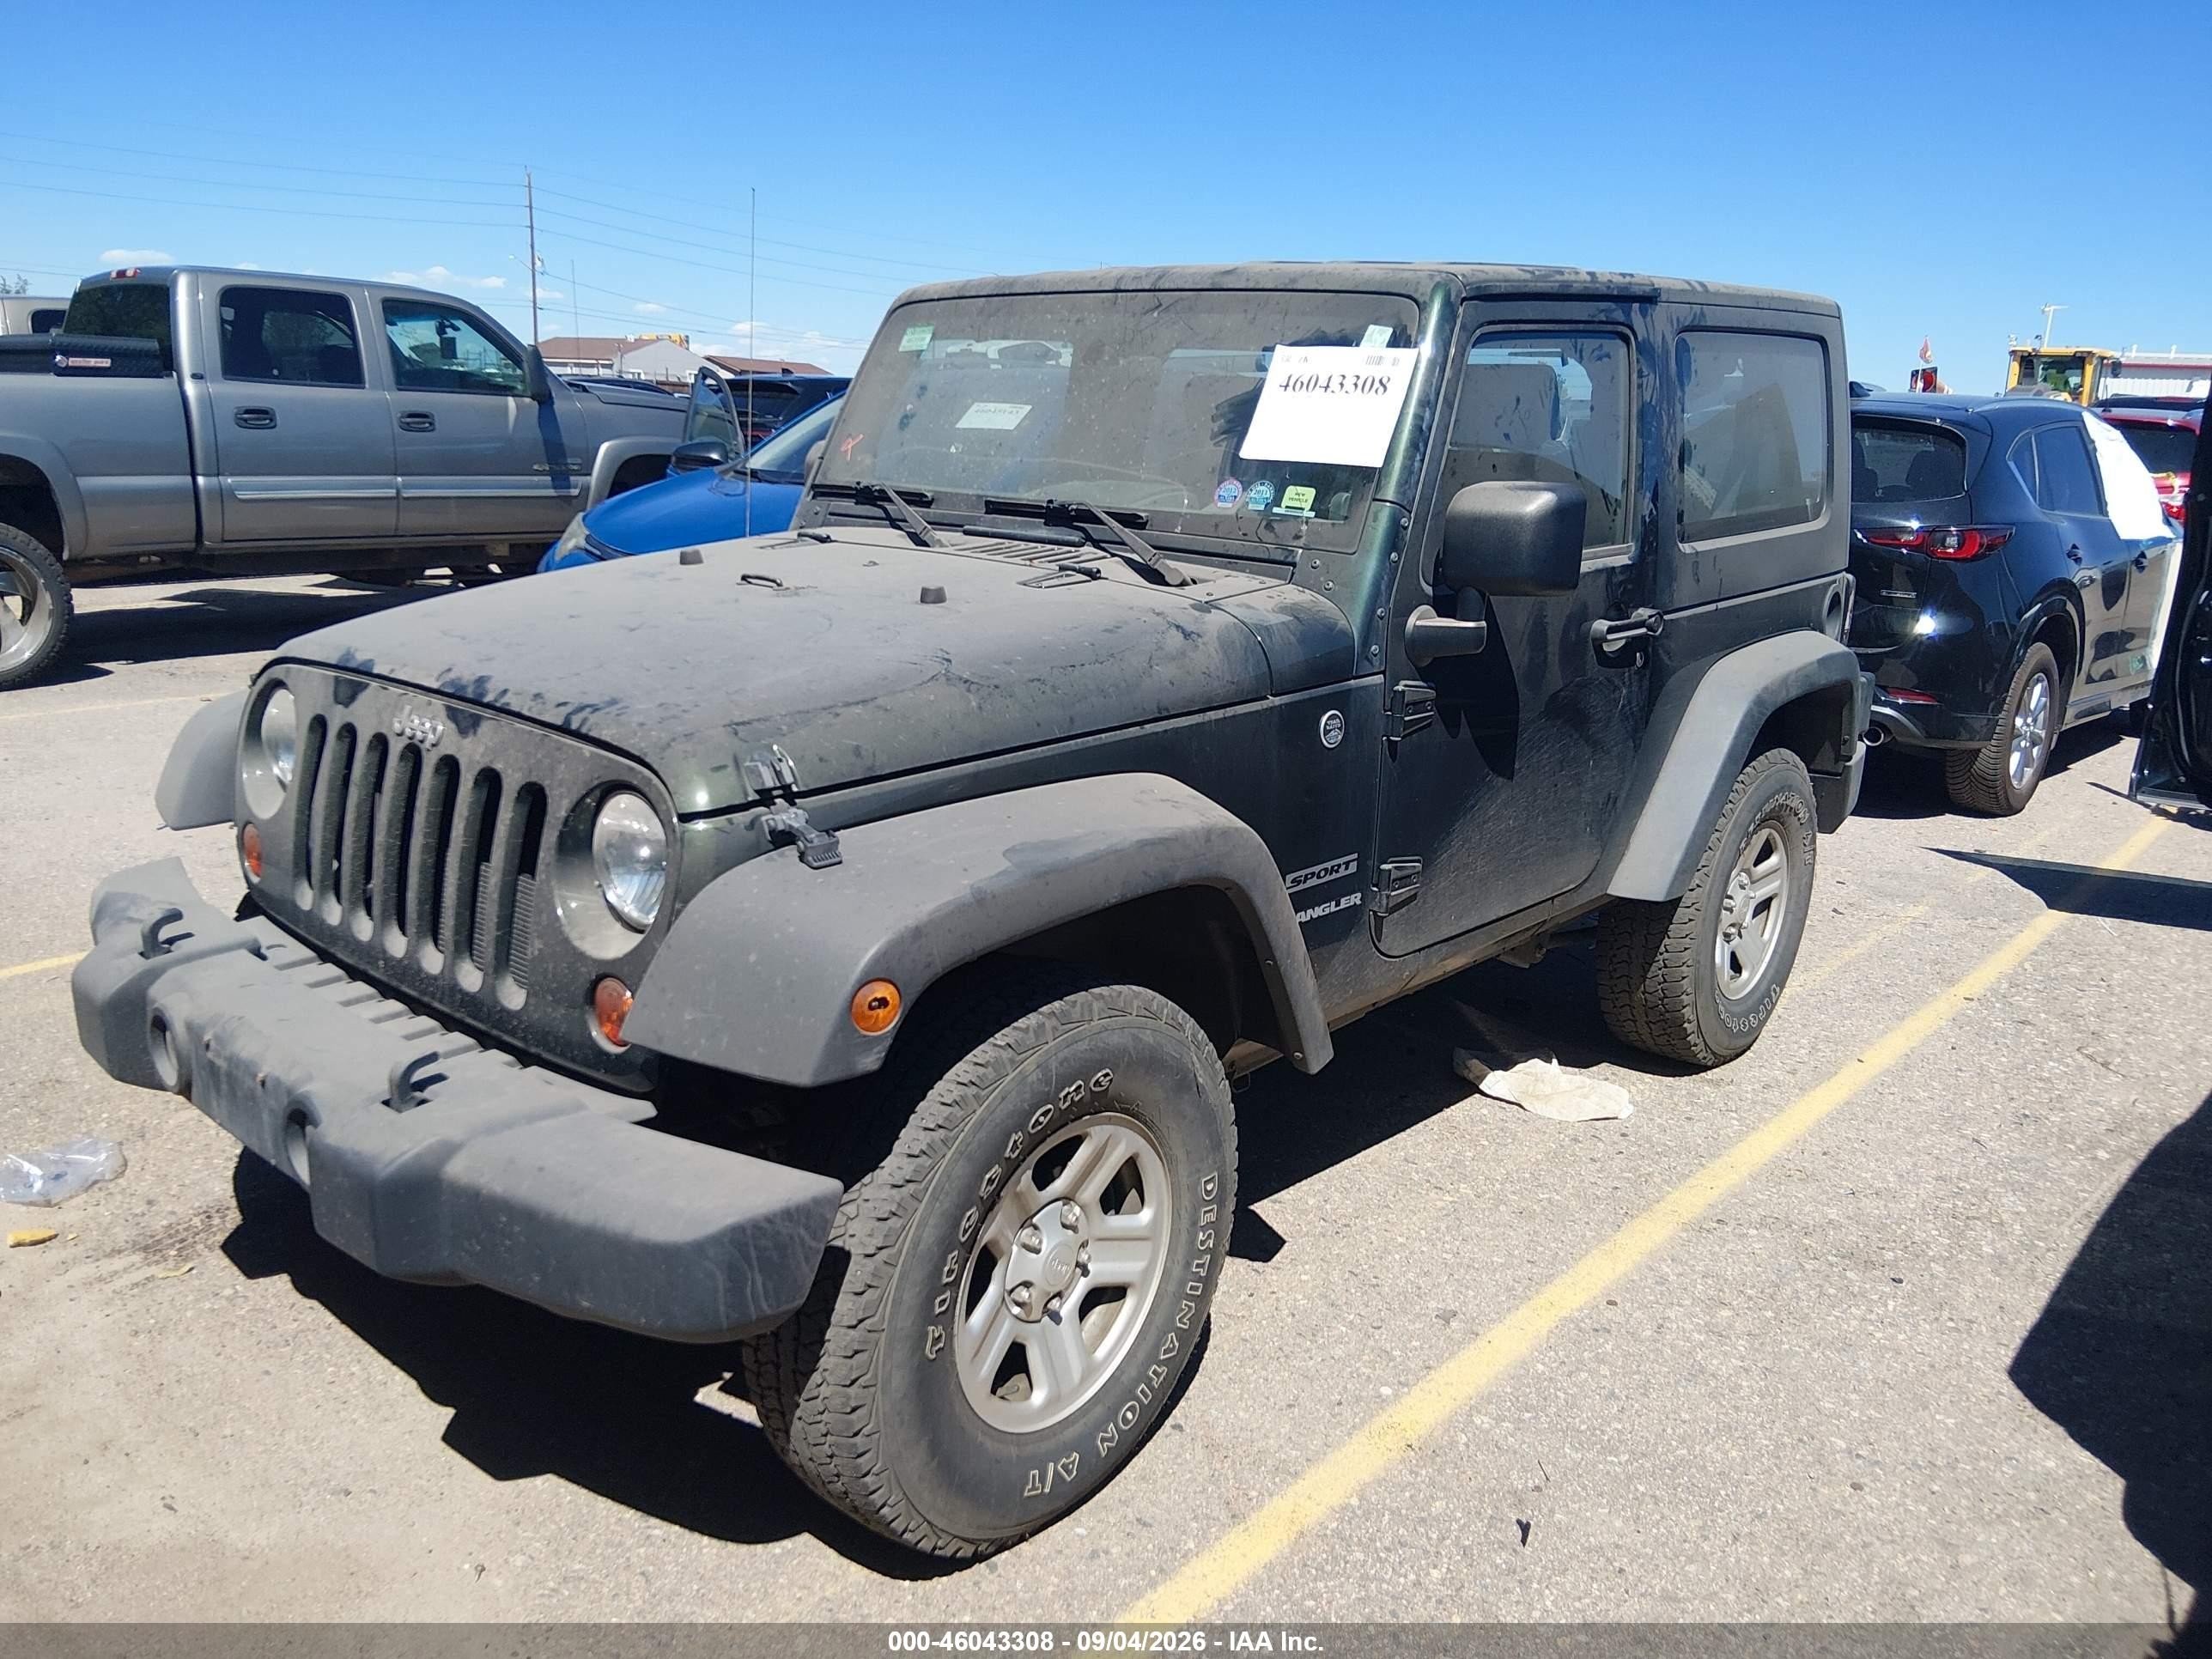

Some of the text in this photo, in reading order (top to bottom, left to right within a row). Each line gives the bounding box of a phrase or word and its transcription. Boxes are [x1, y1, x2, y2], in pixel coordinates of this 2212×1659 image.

[1279, 373, 1391, 396] 46043308
[392, 705, 444, 750] Jeep
[1288, 860, 1354, 887] SPORT
[1296, 892, 1362, 922] ANGLER
[1024, 1172, 1218, 1497] DESTINATION A/T
